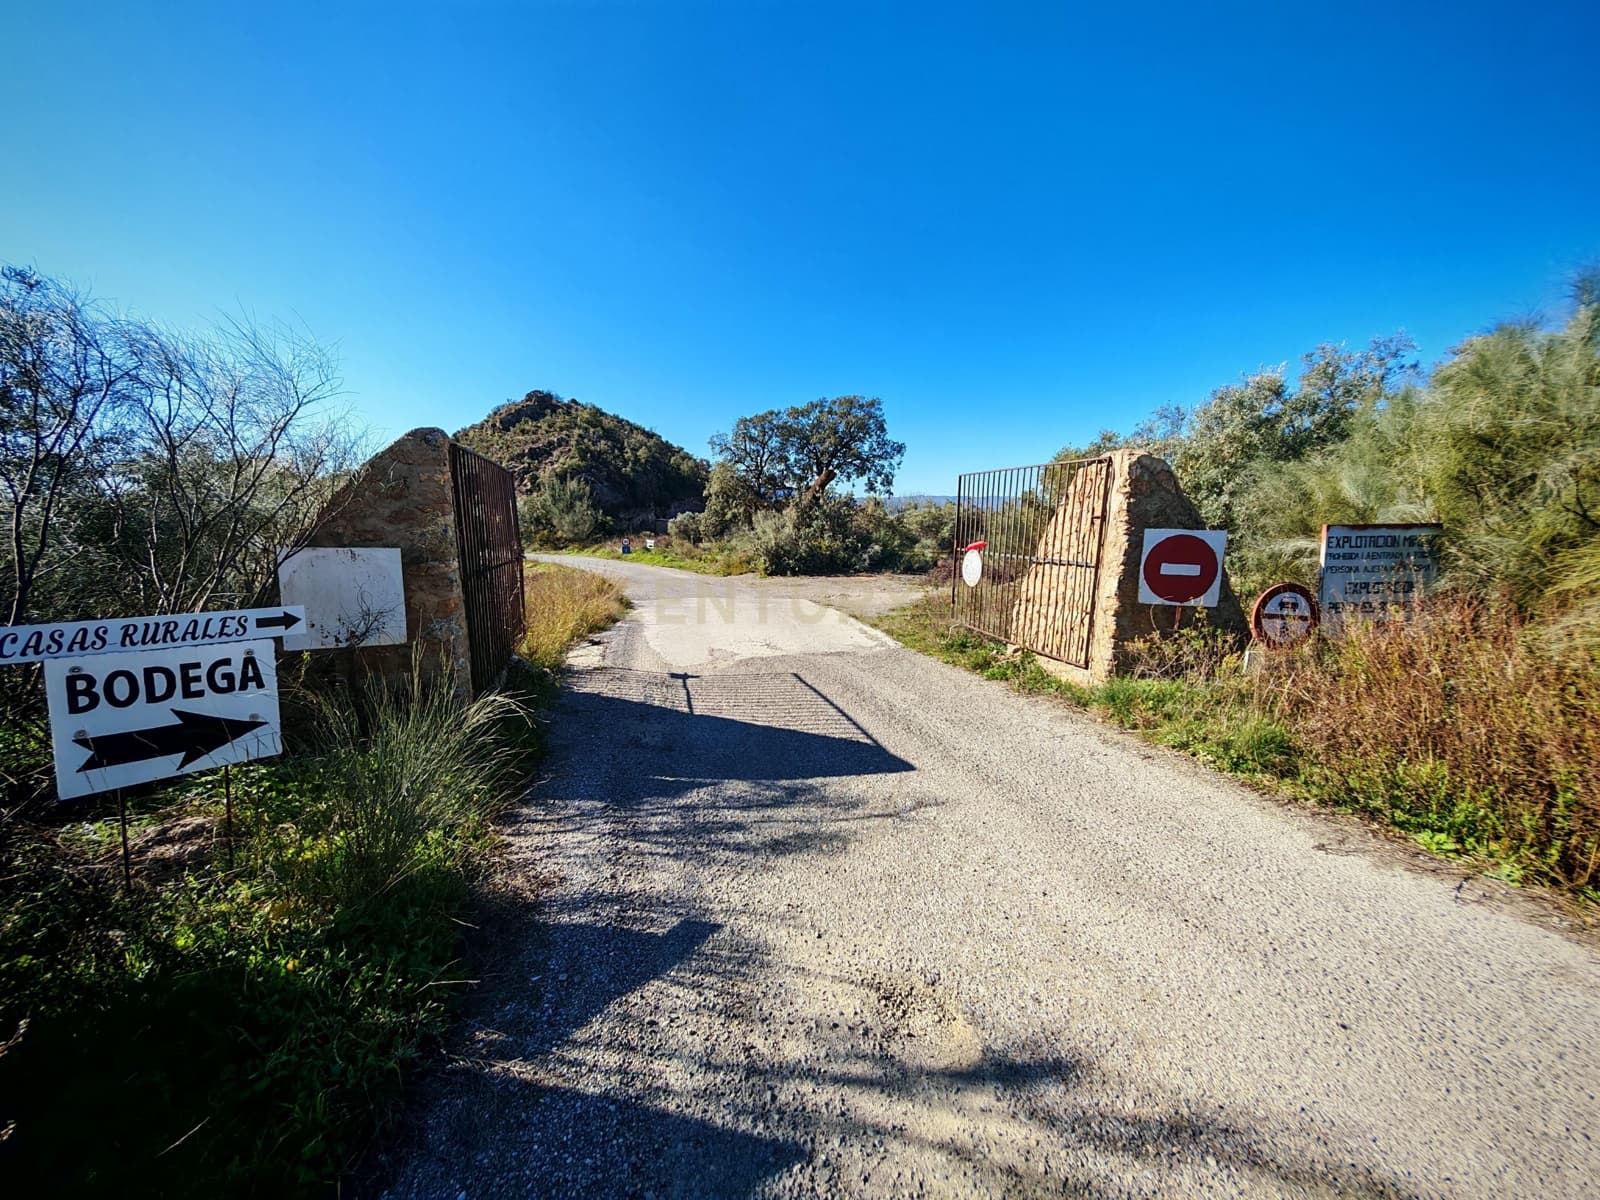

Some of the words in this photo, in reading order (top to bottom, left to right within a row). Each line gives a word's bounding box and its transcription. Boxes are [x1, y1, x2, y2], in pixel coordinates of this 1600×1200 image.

[0, 625, 108, 659] CASAS
[119, 615, 248, 648] RURALES
[65, 656, 265, 715] BODEGA
